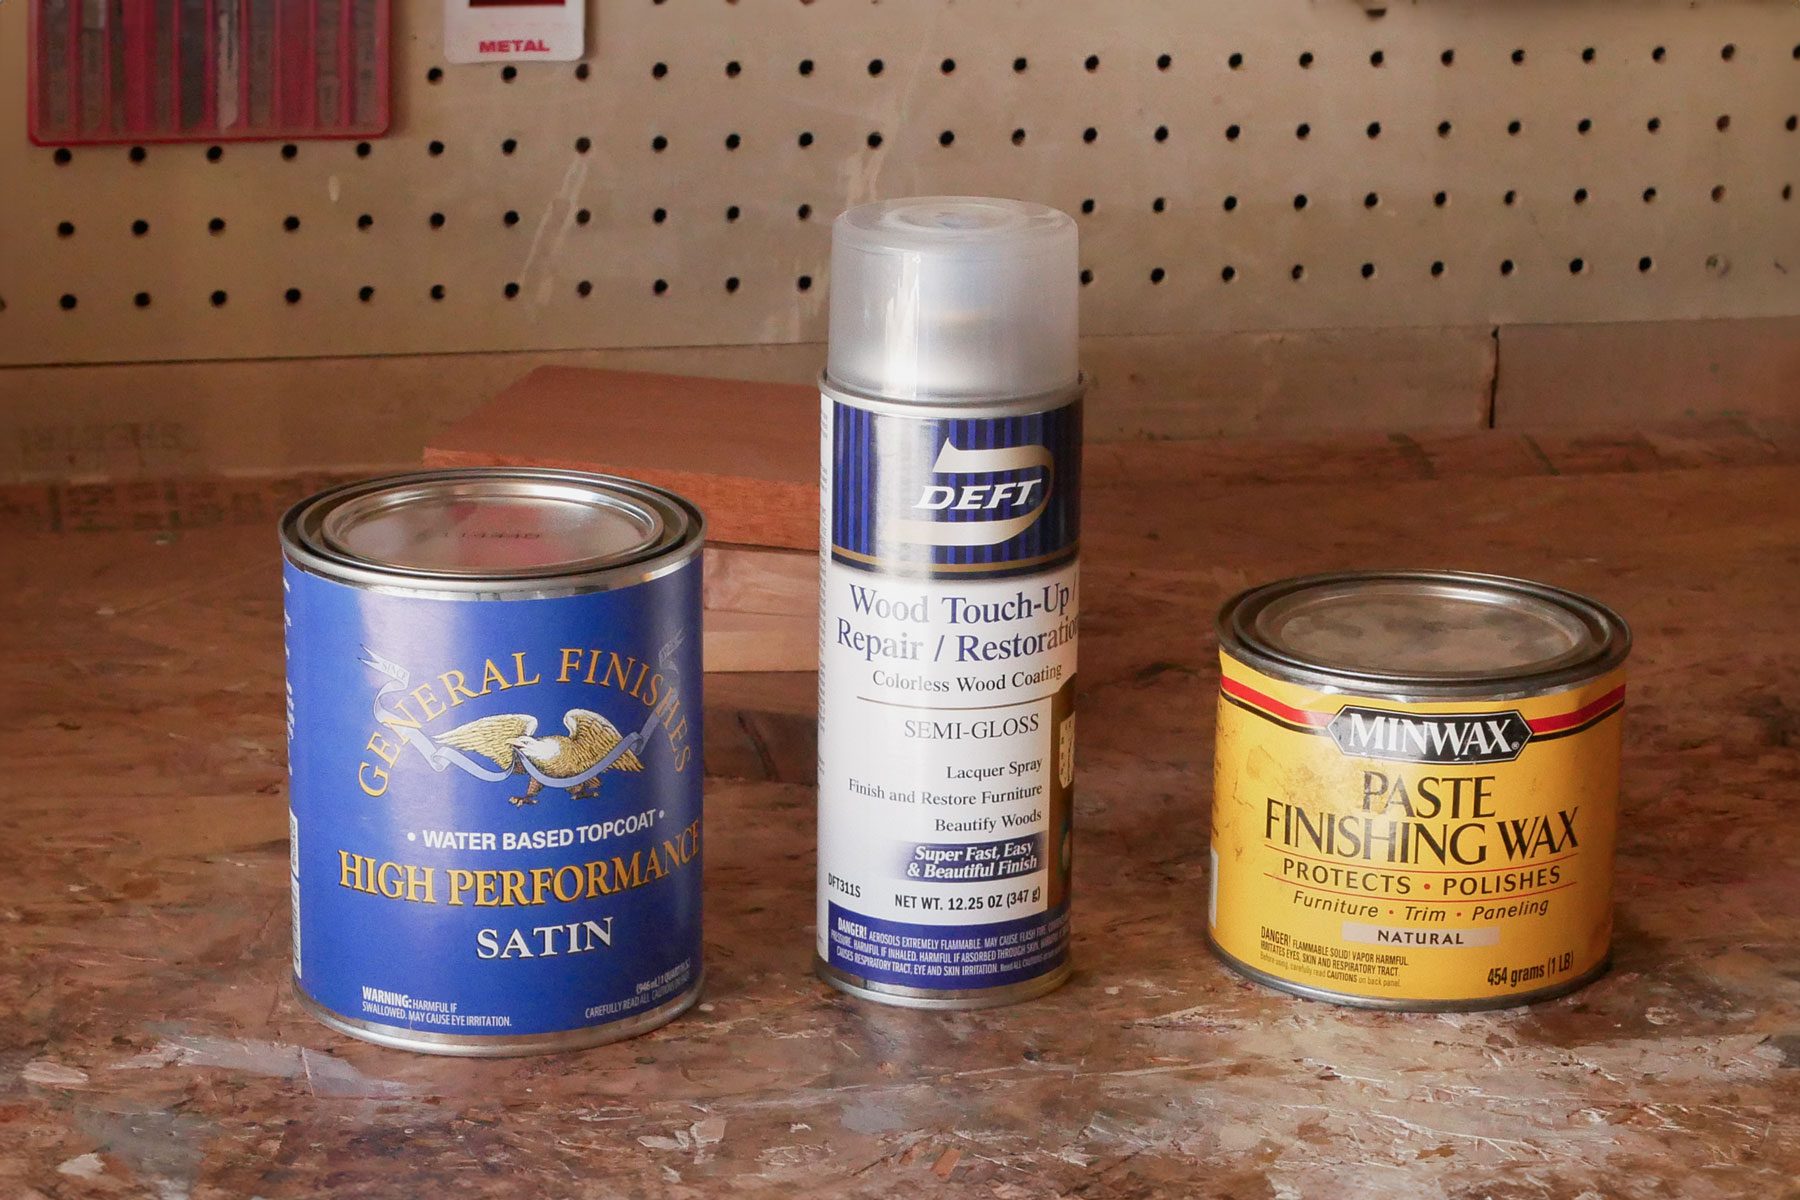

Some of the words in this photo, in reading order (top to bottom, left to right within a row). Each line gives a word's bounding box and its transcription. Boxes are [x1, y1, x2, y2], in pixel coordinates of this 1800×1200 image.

[478, 39, 550, 53] METAL
[912, 478, 1042, 511] DEFT
[849, 583, 930, 623] Wood
[941, 581, 1069, 625] Touch-Up
[836, 616, 924, 662] Repair
[933, 634, 945, 663] /
[872, 669, 950, 693] Colorless
[956, 674, 1006, 693] Wood
[1011, 664, 1062, 689] Coating
[357, 652, 541, 798] GENERAL
[556, 648, 691, 773] FINISHES
[904, 713, 1039, 740] SEMI-GLOSS
[946, 765, 1005, 781] Lacquer
[1008, 757, 1043, 775] Spray
[848, 777, 885, 799] Finish
[889, 789, 916, 804] and
[921, 791, 977, 806] Restore
[981, 782, 1042, 804] Furniture
[1362, 770, 1496, 819] PASTE
[422, 829, 497, 851] WATER
[502, 828, 574, 850] BASED
[576, 809, 657, 847] TOPCOAT
[934, 818, 997, 834] Beautify
[1001, 809, 1042, 828] Woods
[1265, 797, 1488, 866] FINISHING
[1497, 806, 1580, 863] WAX
[338, 849, 438, 904] HIGH
[447, 818, 699, 907] PERFORMANCE
[914, 844, 963, 864] Super
[965, 845, 1001, 861] Fast,
[1003, 841, 1034, 859] Easy
[907, 862, 921, 877] &
[924, 861, 994, 879] Beautiful
[997, 856, 1037, 876] Finish
[1283, 858, 1411, 895] PROTECTS
[1443, 865, 1561, 896] POLISHES
[828, 872, 861, 899] DFT311S
[895, 893, 917, 909] NET
[921, 896, 943, 911] WT.
[948, 897, 984, 911] 12.25
[987, 894, 1003, 909] OZ
[1006, 889, 1029, 909] (347
[1032, 885, 1041, 903] g)
[1293, 890, 1379, 919] Furniture
[1404, 906, 1446, 922] Trim
[1472, 899, 1549, 922] Paneling
[476, 917, 614, 959] SATIN
[838, 916, 867, 939] DANGER!
[868, 930, 901, 947] AEROSOLS
[901, 936, 939, 950] EXTREMELY
[940, 939, 984, 950] FLAMMABLE.
[984, 936, 999, 948] MAY
[1261, 925, 1291, 947] DANGER!
[1292, 939, 1329, 957] FLAMMABLE
[1352, 950, 1374, 963] VAPOR
[1375, 954, 1409, 967] HARMFUL.
[1377, 929, 1465, 946] NATURAL
[854, 952, 891, 971] RESPIRATORY
[914, 965, 926, 976] EYE
[927, 965, 943, 976] AND
[943, 964, 961, 977] SKIN
[881, 946, 887, 957] IF
[888, 948, 918, 962] INHALED.
[919, 952, 952, 964] HARMFUL
[953, 953, 961, 963] IF
[961, 950, 996, 963] ABSORBED
[1260, 939, 1286, 957] IRRITATES
[1302, 953, 1317, 966] SKIN
[1317, 956, 1331, 969] AND
[1332, 959, 1376, 975] RESPIRATORY
[1290, 959, 1312, 977] carefully
[1313, 969, 1326, 979] read
[1326, 970, 1358, 984] CAUTIONS
[1358, 976, 1367, 985] on
[1367, 975, 1382, 986] back
[1486, 966, 1508, 986] 454
[1510, 963, 1545, 989] grams
[1547, 960, 1556, 980] (1
[1558, 951, 1574, 974] LB)
[362, 985, 412, 1009] WARNING:
[412, 999, 450, 1013] HARMFUL
[450, 1002, 458, 1013] IF
[585, 1000, 623, 1019] CAREFULLY
[623, 996, 640, 1010] READ
[362, 1001, 408, 1019] SWALLOWED.
[408, 1009, 425, 1023] MAY
[426, 1012, 451, 1026] CAUSE
[451, 1015, 466, 1026] EYE
[466, 1015, 512, 1027] IRRITATION.
